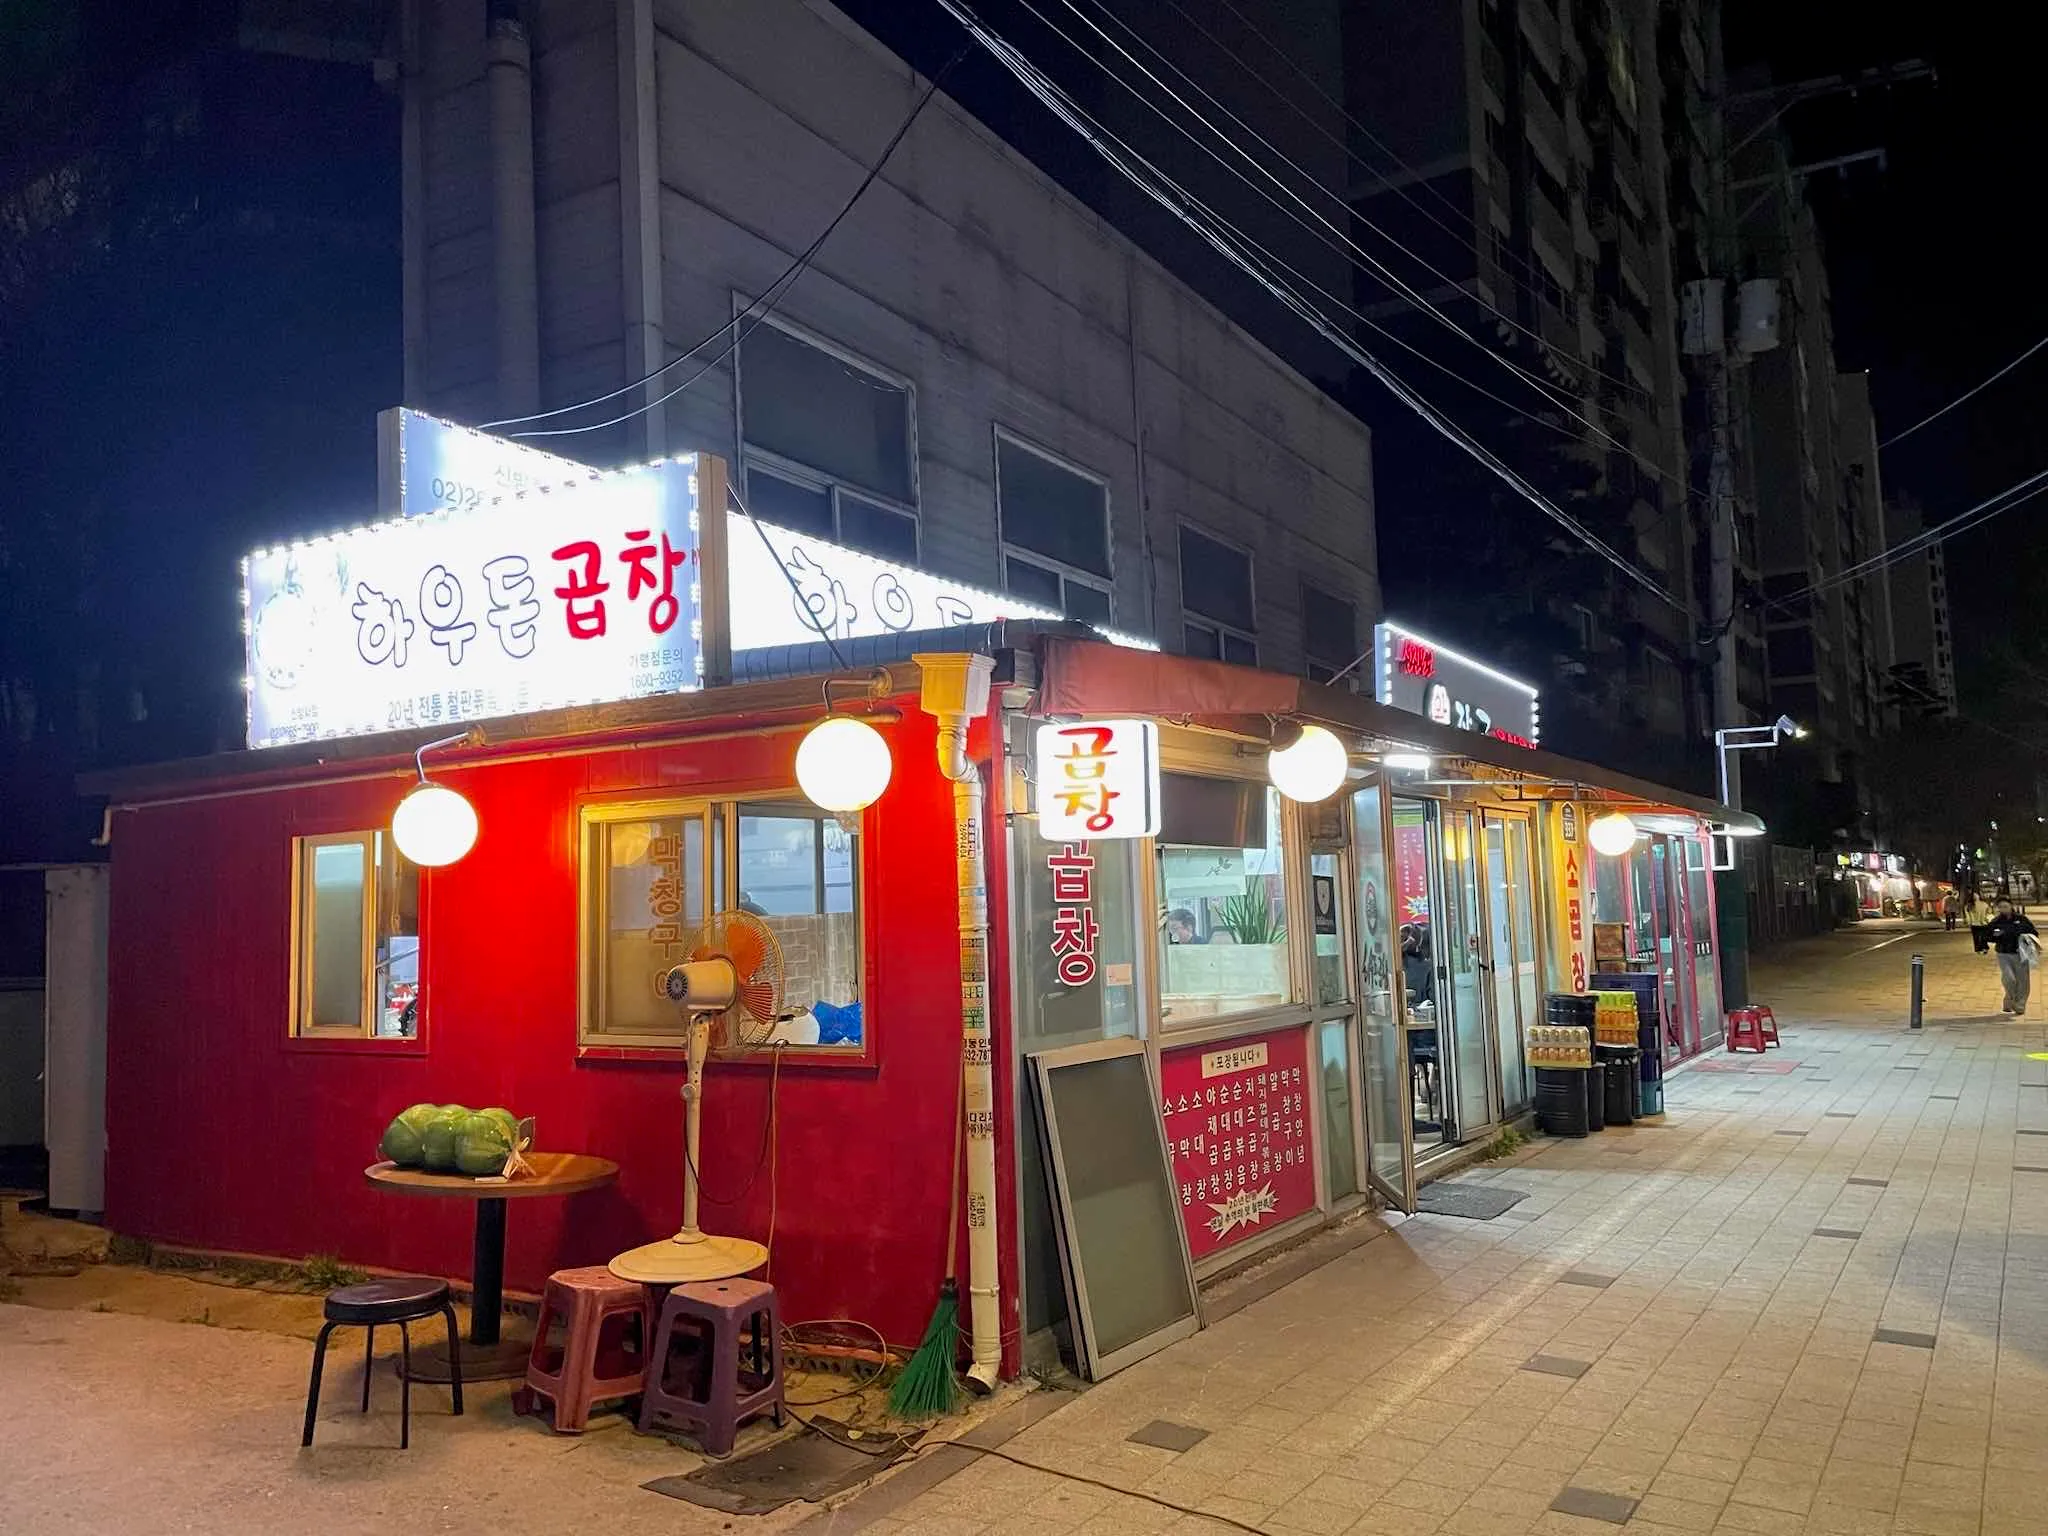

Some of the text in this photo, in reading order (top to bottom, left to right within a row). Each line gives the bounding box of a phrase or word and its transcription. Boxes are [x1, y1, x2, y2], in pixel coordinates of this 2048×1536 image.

[352, 528, 688, 669] 하우돈 곱창
[1053, 726, 1121, 832] 곱창
[1215, 1048, 1255, 1070] 포장됩니다
[1206, 1086, 1221, 1196] 야채곱창
[1219, 1083, 1234, 1191] 순대곱창
[1245, 1076, 1259, 1182] 치즈곱창
[1281, 1068, 1295, 1167] 막창구이
